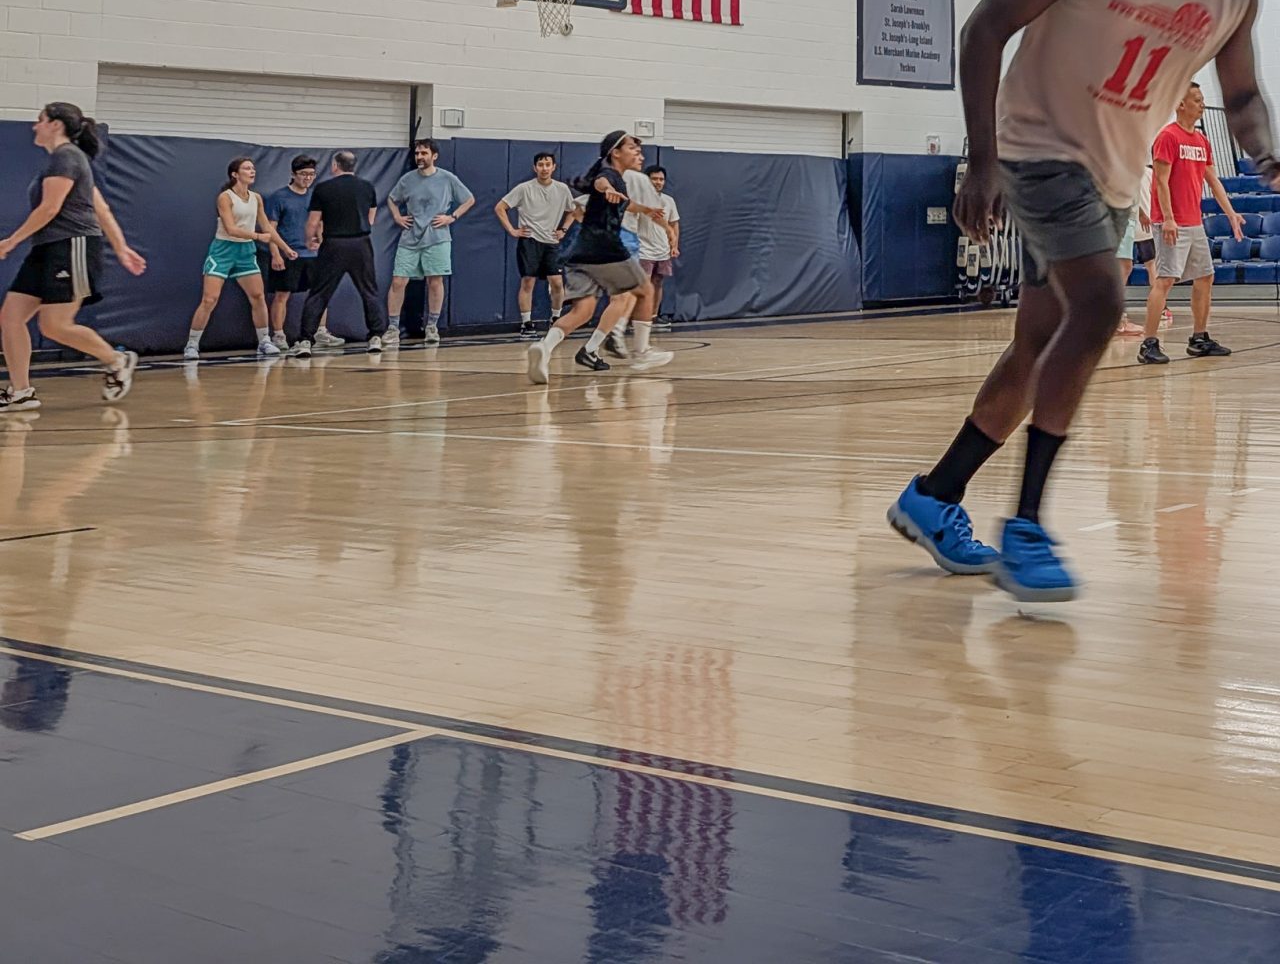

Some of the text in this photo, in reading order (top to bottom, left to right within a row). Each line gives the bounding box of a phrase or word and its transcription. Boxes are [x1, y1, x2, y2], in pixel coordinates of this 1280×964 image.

[890, 3, 925, 16] Sarah Lawrence
[1103, 34, 1172, 102] 11
[1179, 144, 1208, 162] CORNELL
